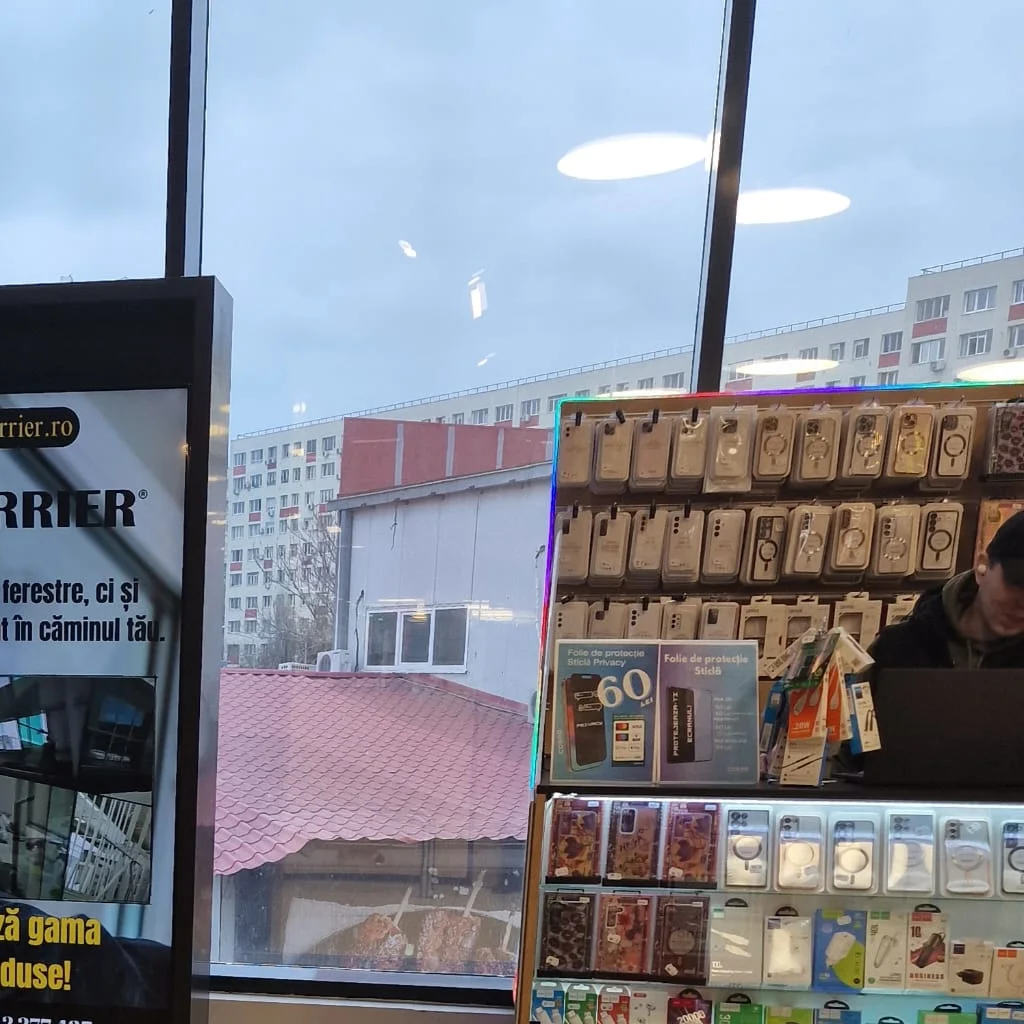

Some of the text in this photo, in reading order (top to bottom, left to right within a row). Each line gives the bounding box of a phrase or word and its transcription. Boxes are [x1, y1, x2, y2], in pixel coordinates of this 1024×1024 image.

[2, 579, 89, 607] ferestre,
[96, 577, 114, 604] ci
[14, 615, 33, 642] în
[39, 614, 121, 642] căminul
[567, 649, 589, 657] Folie
[591, 649, 603, 657] de
[593, 659, 626, 668] Privacy
[664, 653, 688, 663] Folie
[690, 653, 703, 663] de
[597, 668, 651, 708] 60
[27, 916, 102, 946] gama
